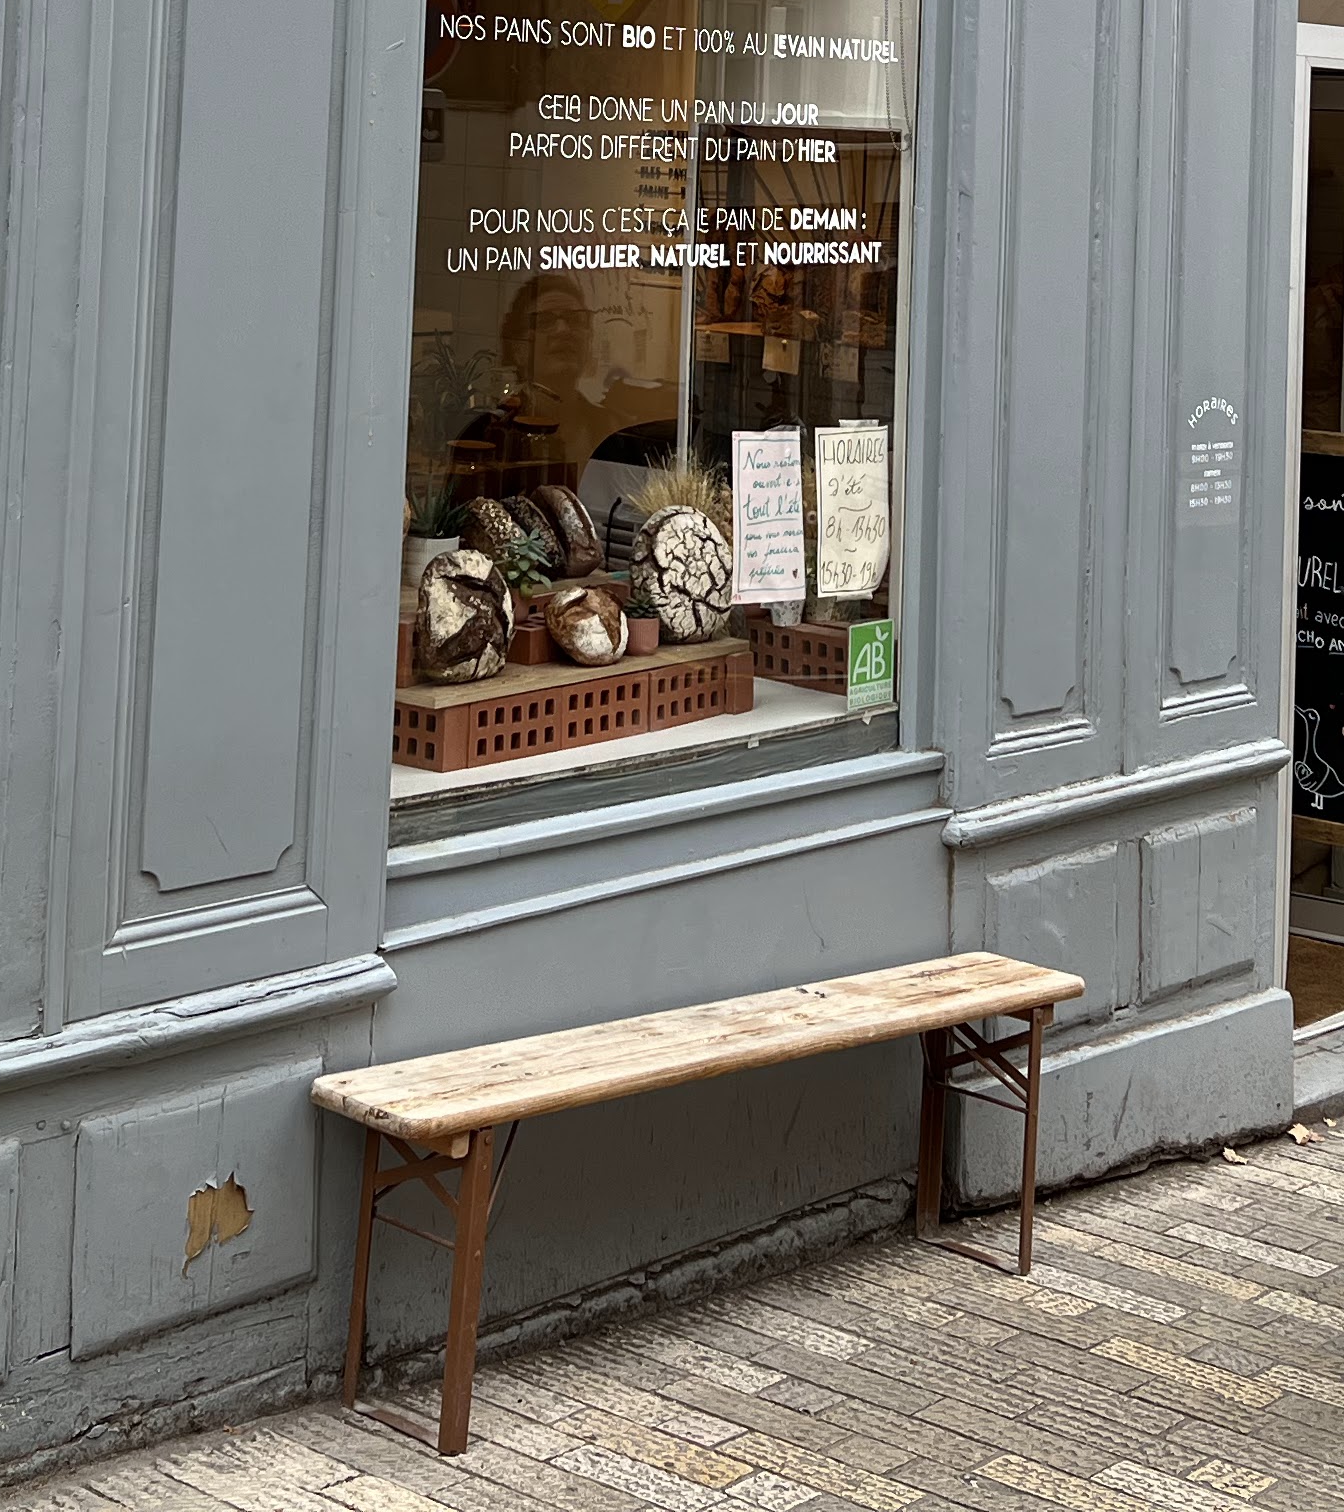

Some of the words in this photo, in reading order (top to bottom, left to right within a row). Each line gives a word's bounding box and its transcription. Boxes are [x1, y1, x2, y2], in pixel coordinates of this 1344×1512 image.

[440, 14, 486, 41] NOS
[494, 16, 552, 45] PAINS
[560, 20, 616, 47] SONT
[622, 24, 656, 49] BIO
[663, 26, 687, 51] ET
[693, 28, 736, 54] 100%
[743, 32, 768, 55] AU
[773, 33, 825, 59] LEVAIN
[829, 37, 899, 64] NATUREL
[538, 94, 582, 123] CELA
[589, 95, 654, 122] DONNE
[661, 99, 688, 123] UN
[694, 99, 735, 124] PAIN
[740, 101, 766, 125] DU
[771, 102, 819, 126] JOUR
[509, 132, 593, 160] PARFOIS
[600, 133, 699, 162] DIFFÉRENT
[705, 137, 731, 162] DU
[736, 137, 776, 162] PAIN
[469, 208, 530, 235] POUR
[536, 208, 595, 234] NOUS
[602, 206, 655, 233] C'EST
[662, 207, 690, 237] ÇA
[697, 207, 710, 234] LE
[716, 207, 756, 231] PAIN
[762, 207, 784, 231] DE
[790, 207, 857, 231] DEMAIN
[447, 246, 479, 273] UN
[485, 246, 532, 272] PAIN
[650, 243, 731, 269] NATUREL
[736, 242, 759, 266] ET
[764, 240, 882, 265] NOURRISSANT
[743, 449, 771, 470] Nous
[822, 437, 885, 465] HORAIRES
[742, 493, 770, 521] tout
[825, 515, 842, 543] 8h
[1296, 629, 1325, 649] CHO
[852, 641, 886, 684] AB
